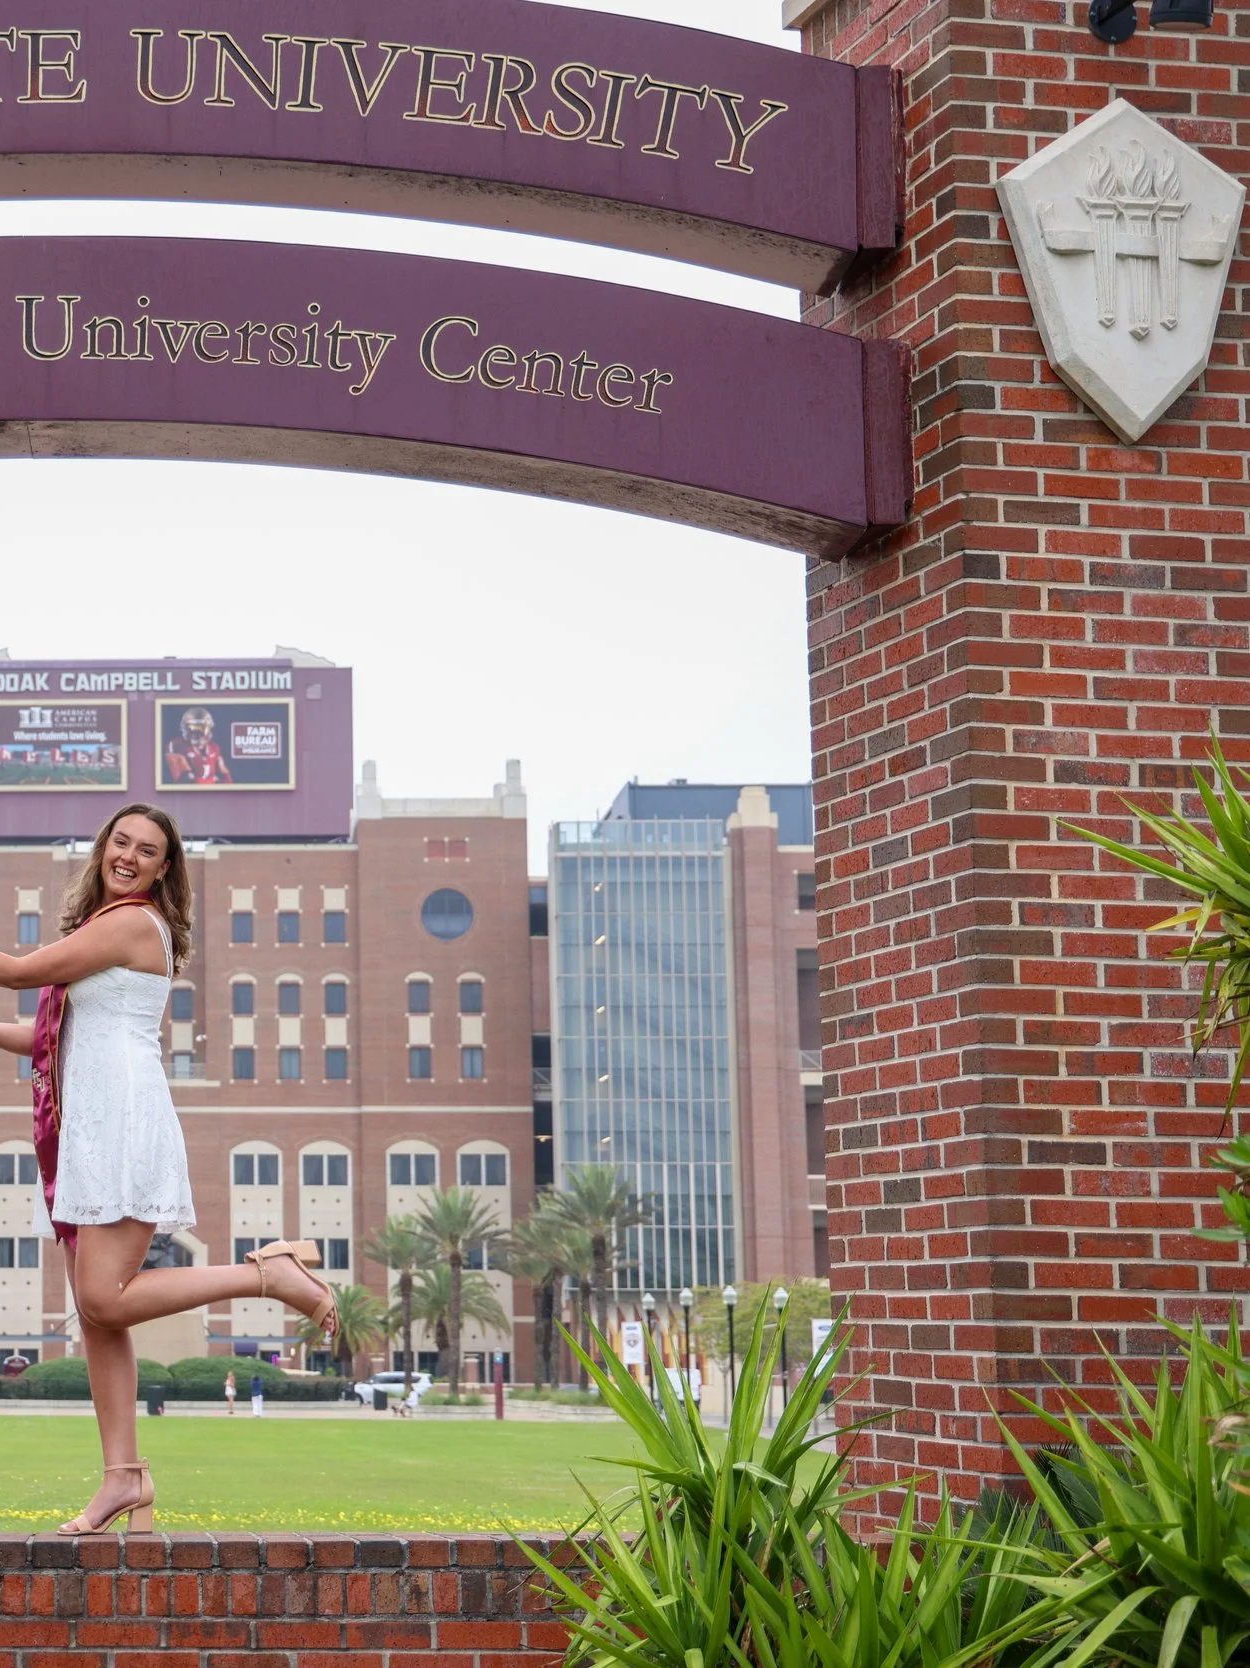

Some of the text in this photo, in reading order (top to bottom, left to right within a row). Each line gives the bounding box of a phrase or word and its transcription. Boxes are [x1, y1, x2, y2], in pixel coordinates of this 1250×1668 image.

[130, 28, 789, 175] UNIVERSITY
[15, 294, 397, 396] University
[419, 315, 674, 414] Center
[59, 670, 181, 692] CAMPBELL
[191, 669, 293, 691] STADIUM
[13, 730, 37, 740] Where
[38, 730, 68, 740] students
[246, 726, 276, 736] FARM
[234, 735, 277, 745] BUREAU
